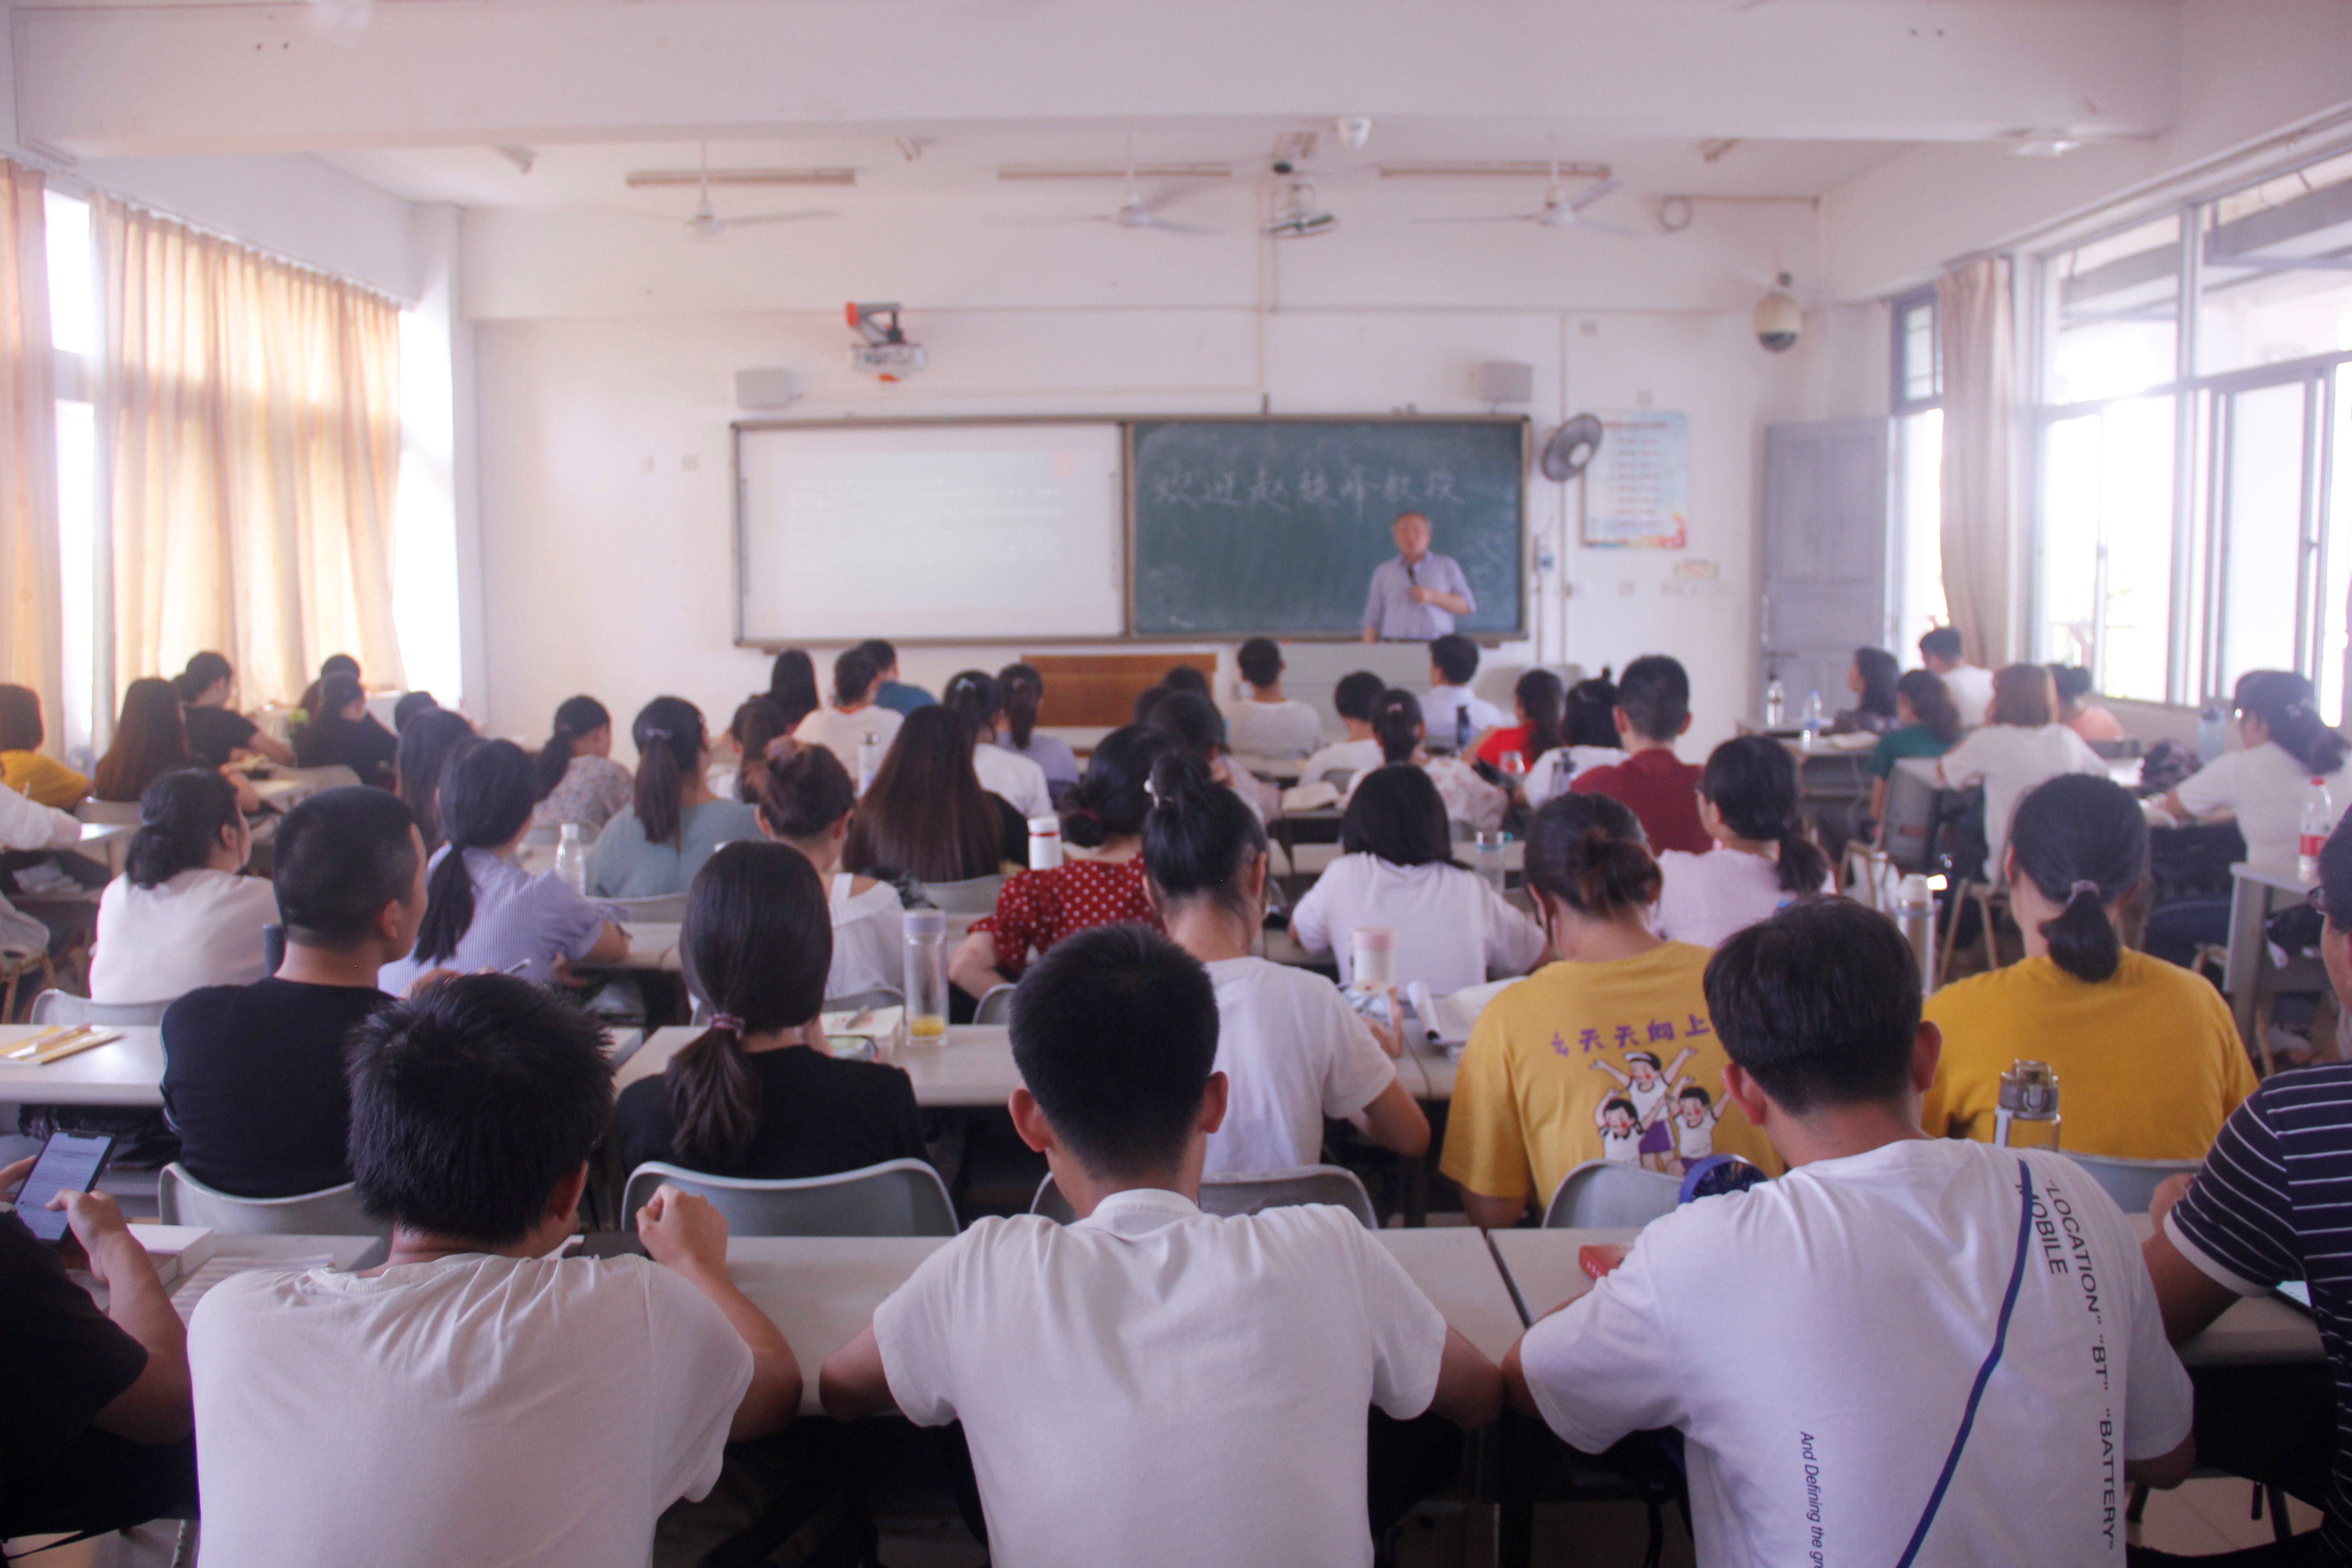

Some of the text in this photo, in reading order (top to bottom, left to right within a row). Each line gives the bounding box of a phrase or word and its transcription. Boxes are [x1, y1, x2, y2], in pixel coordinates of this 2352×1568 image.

[1800, 1431, 1817, 1461] And
[1804, 1464, 1823, 1522] Defining
[1811, 1526, 1824, 1548] the
